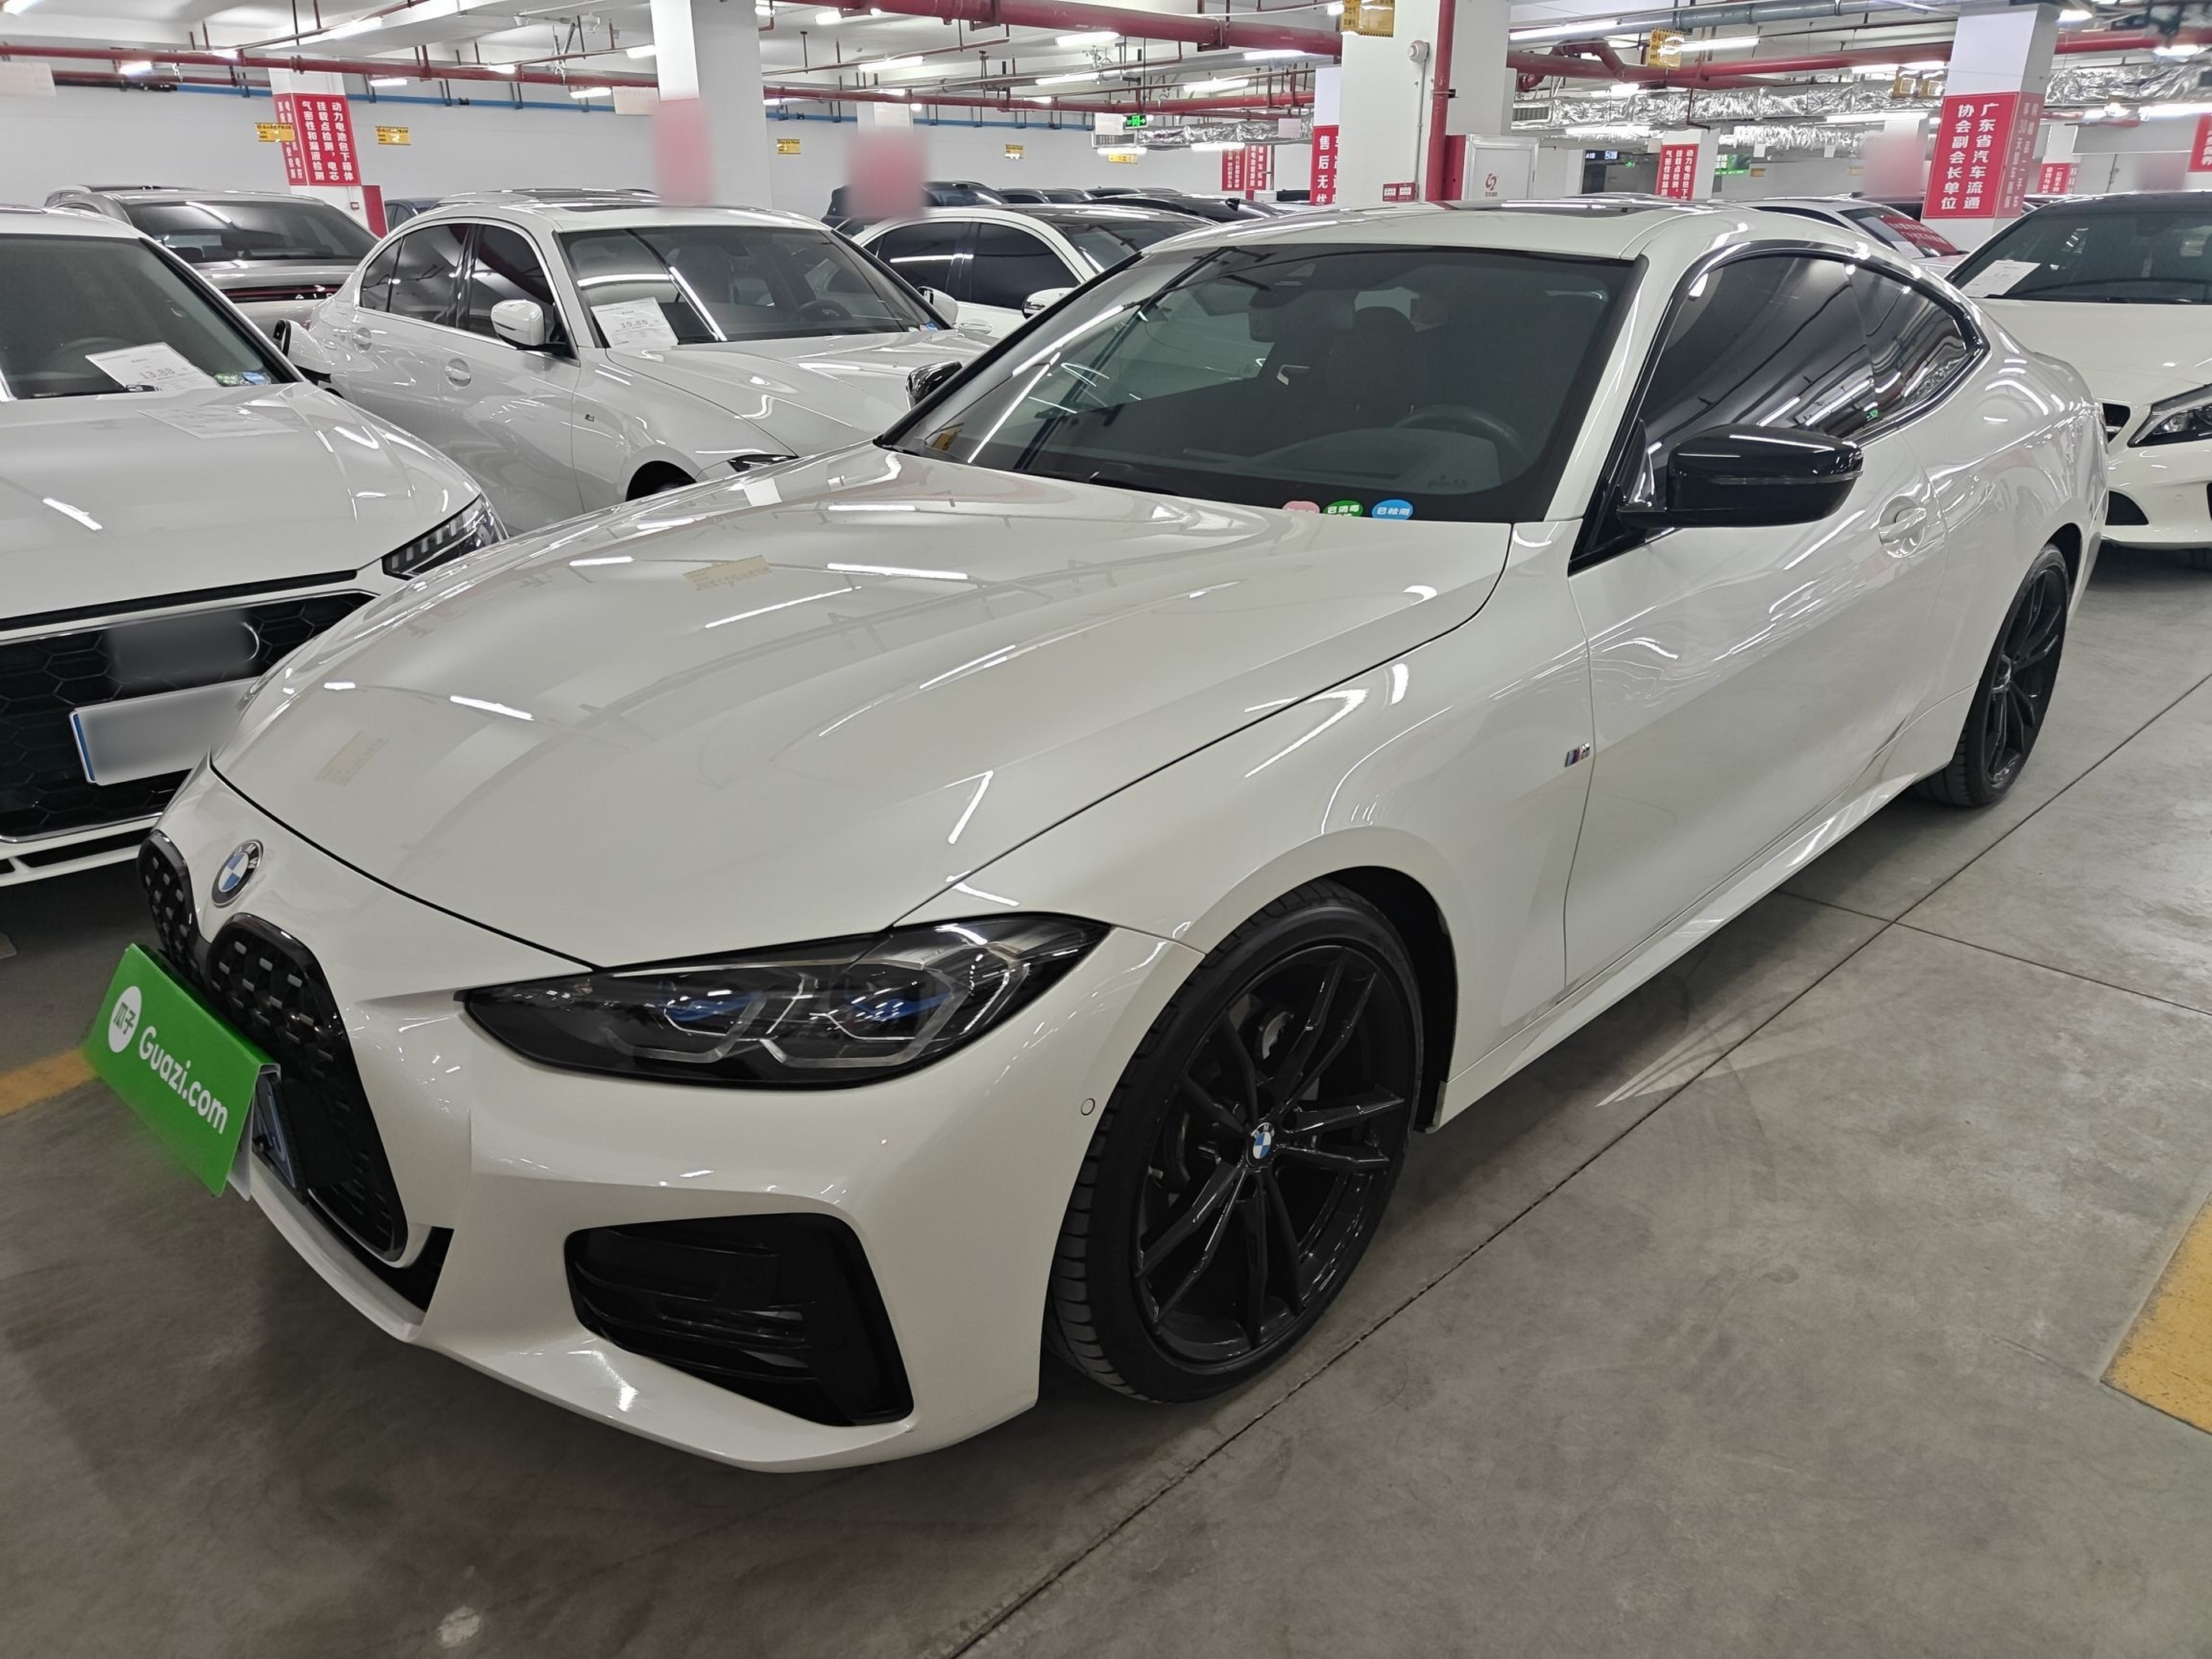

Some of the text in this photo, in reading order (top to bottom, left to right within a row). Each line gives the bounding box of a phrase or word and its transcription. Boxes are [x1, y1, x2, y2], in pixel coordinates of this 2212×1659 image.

[302, 100, 325, 181] 气密性和漏液检测
[331, 101, 354, 181] 动力电池包下箱体
[1672, 150, 1683, 198] 挂载点检测，
[1681, 150, 1694, 198] 动力电池包下
[1941, 104, 1975, 210] 协会副会长单位
[1963, 103, 1999, 209] 广东省汽车流通
[113, 1002, 137, 1035] 瓜子
[139, 1026, 229, 1135] Guazi.com
